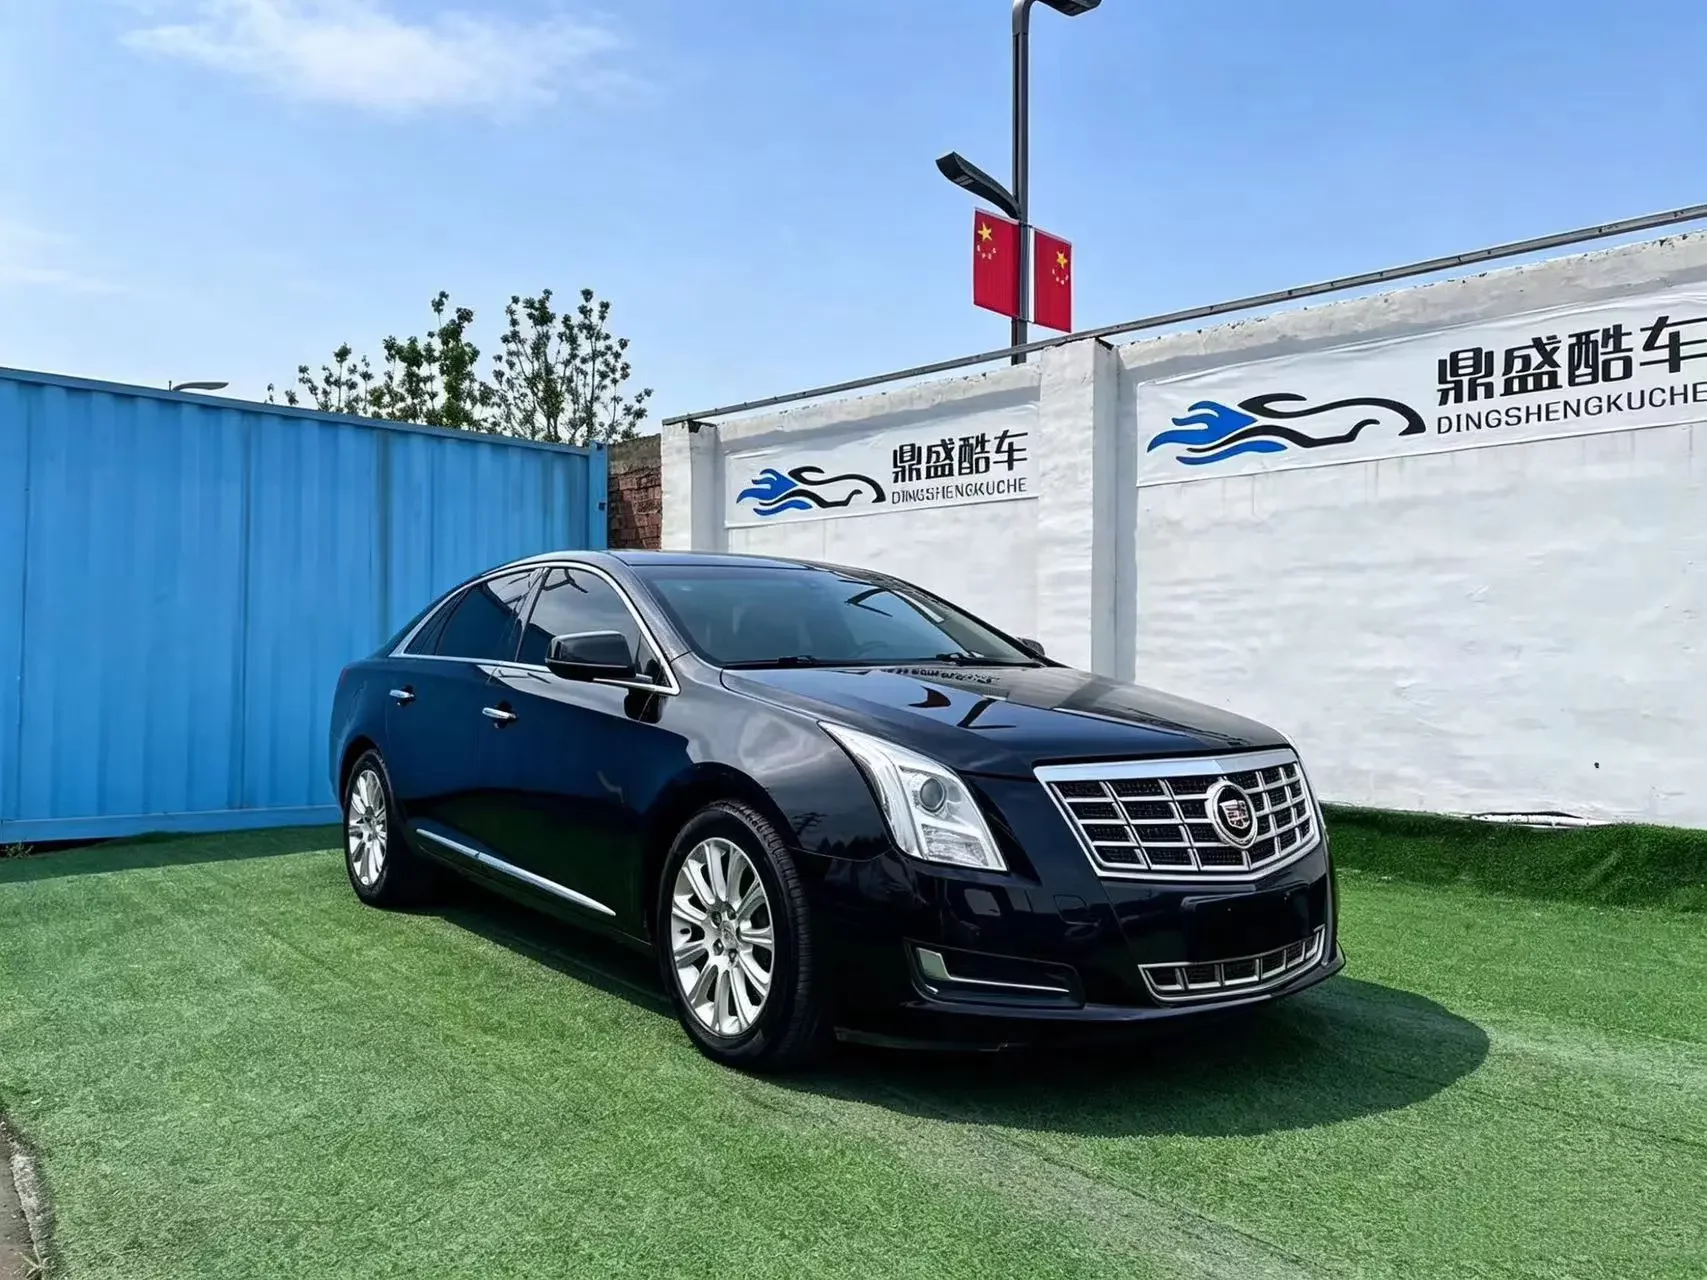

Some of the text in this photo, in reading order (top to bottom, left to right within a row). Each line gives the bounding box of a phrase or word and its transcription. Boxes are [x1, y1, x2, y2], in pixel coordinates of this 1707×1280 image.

[1437, 316, 1707, 406] 鼎盛酷车
[1437, 382, 1707, 434] DINGSHENGKUCHE
[892, 429, 1028, 483] 鼎盛酷车
[891, 477, 1027, 504] DINGSHENGKUCHE
